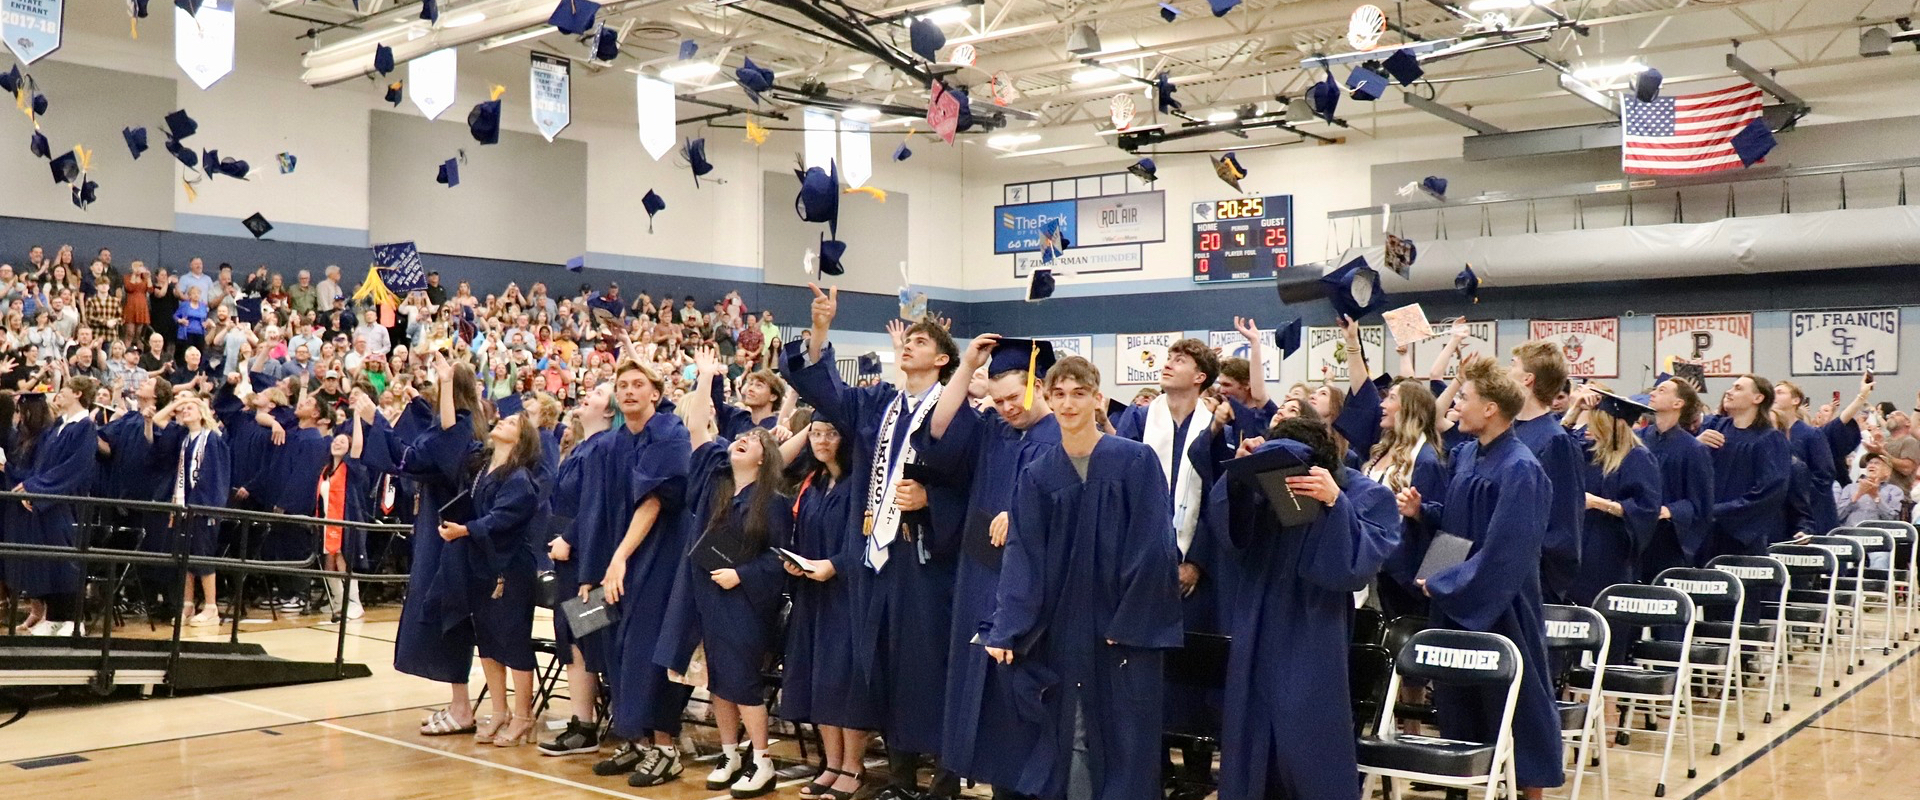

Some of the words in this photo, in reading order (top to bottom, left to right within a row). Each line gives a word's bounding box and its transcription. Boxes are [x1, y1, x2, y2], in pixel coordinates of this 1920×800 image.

[11, 2, 48, 16] ENTRANT
[2, 11, 56, 34] 2017-18
[1217, 199, 1263, 219] 20:25
[1197, 223, 1218, 231] HOME
[1261, 217, 1285, 227] GUEST
[1008, 241, 1021, 249] GO
[1200, 232, 1221, 251] 20
[1235, 233, 1245, 246] 4
[1265, 228, 1287, 246] 25
[1090, 252, 1138, 263] THUNDER
[1200, 258, 1209, 273] 0
[1277, 253, 1287, 268] 0
[1533, 322, 1569, 340] NORTH
[1570, 320, 1615, 341] BRANCH
[1658, 316, 1750, 341] PRINCETON
[1795, 314, 1820, 337] ST.
[1822, 311, 1895, 334] FRANCIS
[1127, 336, 1141, 349] BIG
[1143, 335, 1170, 347] LAKE
[1691, 331, 1713, 360] P
[1814, 349, 1875, 371] SAINTS
[1607, 596, 1678, 615] THUNDER
[1545, 620, 1591, 638] NDER
[1414, 644, 1500, 670] THUNDER
